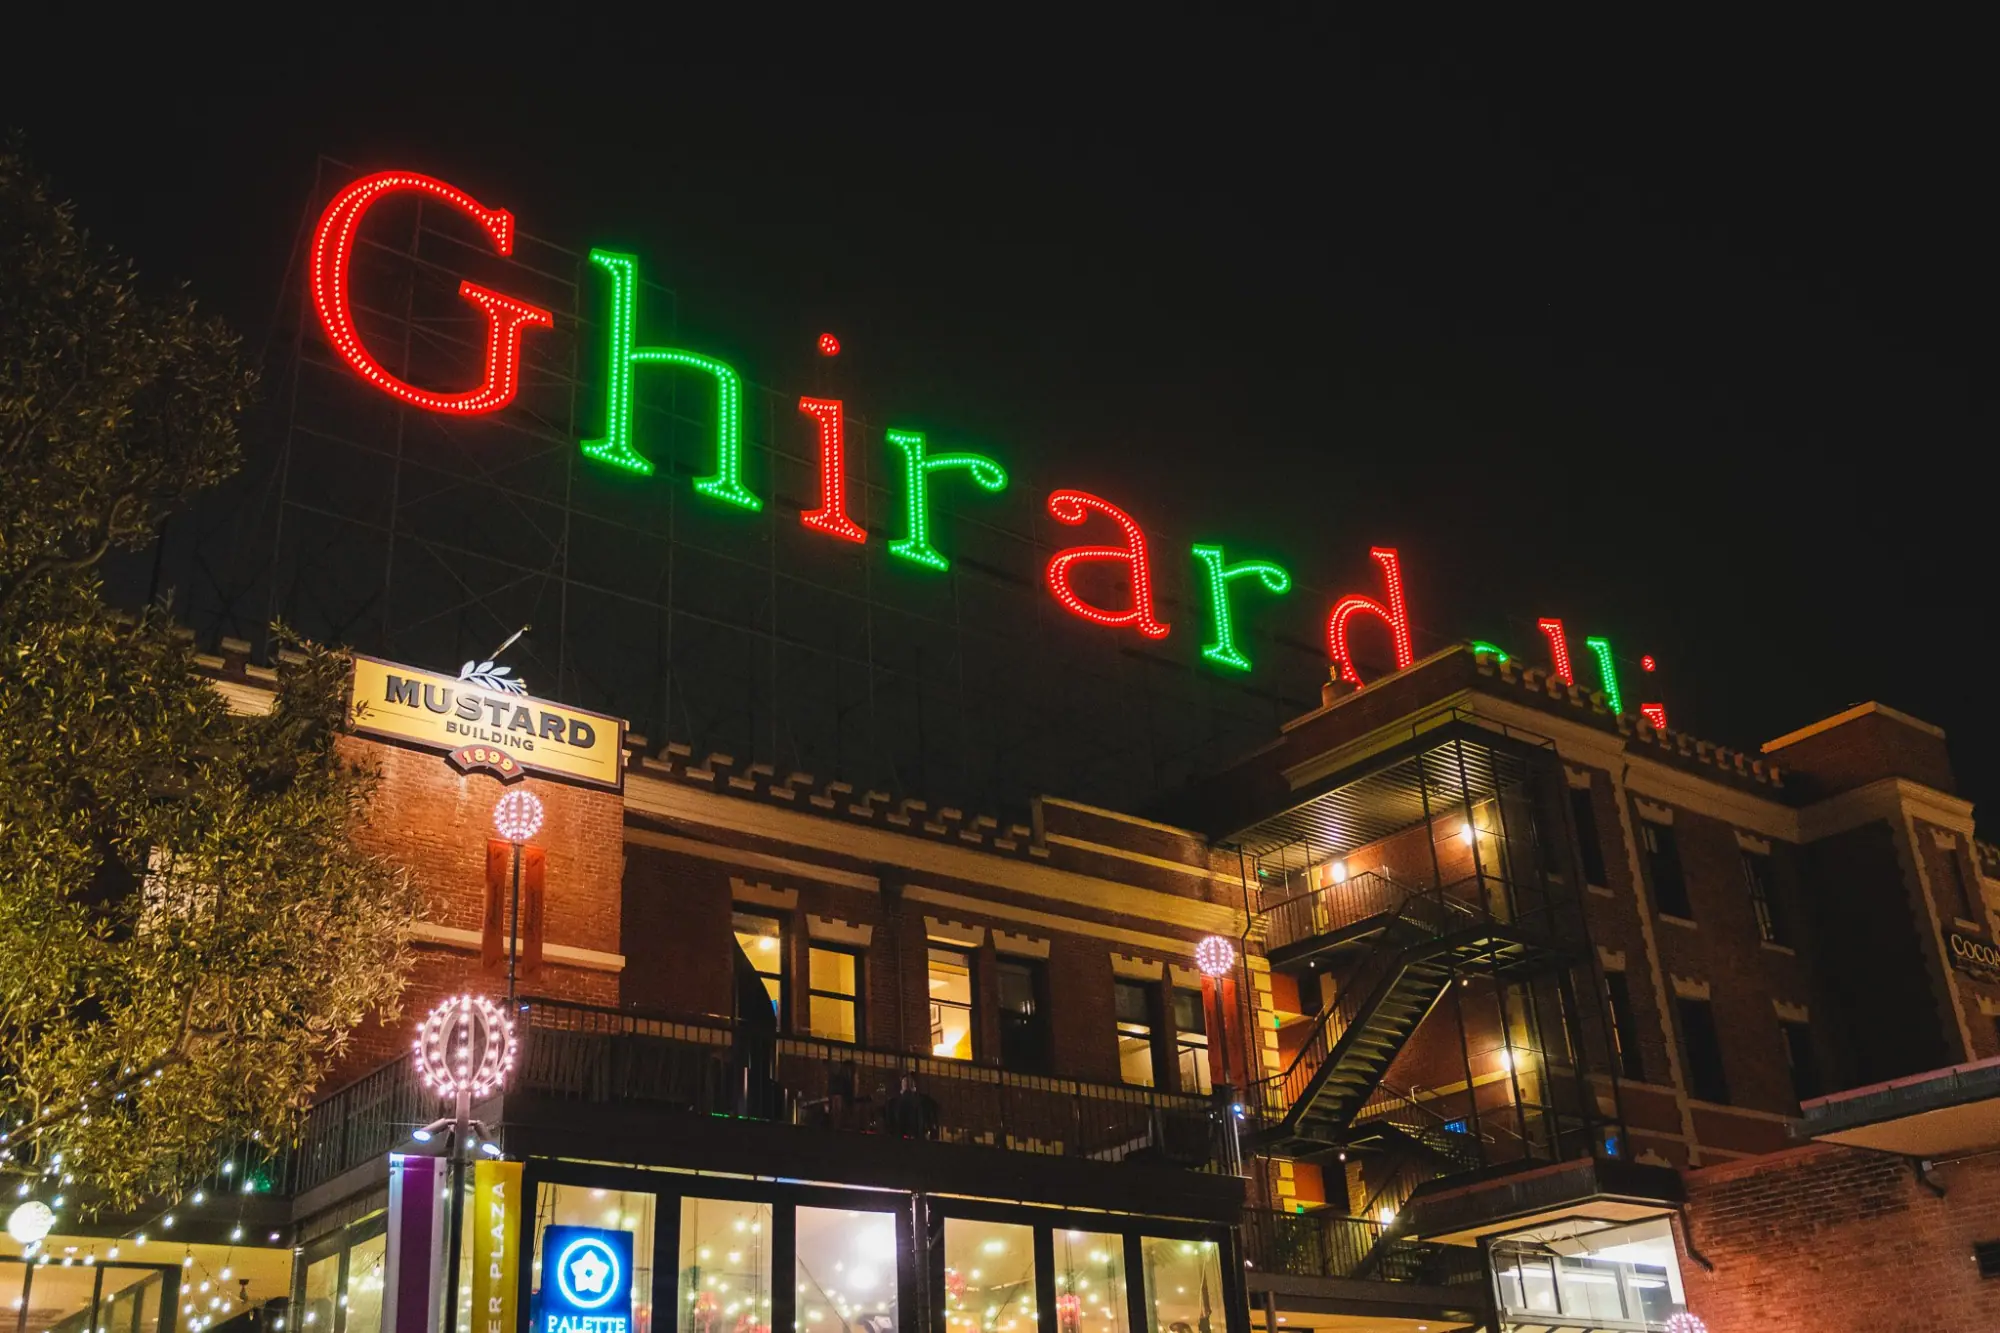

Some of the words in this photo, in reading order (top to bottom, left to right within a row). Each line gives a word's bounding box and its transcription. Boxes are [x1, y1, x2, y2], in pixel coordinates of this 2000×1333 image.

[385, 674, 596, 749] MUSTARD
[446, 720, 535, 751] BUILDING
[461, 749, 514, 771] 1899
[490, 1181, 505, 1280] PLAZA
[547, 1314, 627, 1333] PALETTE
